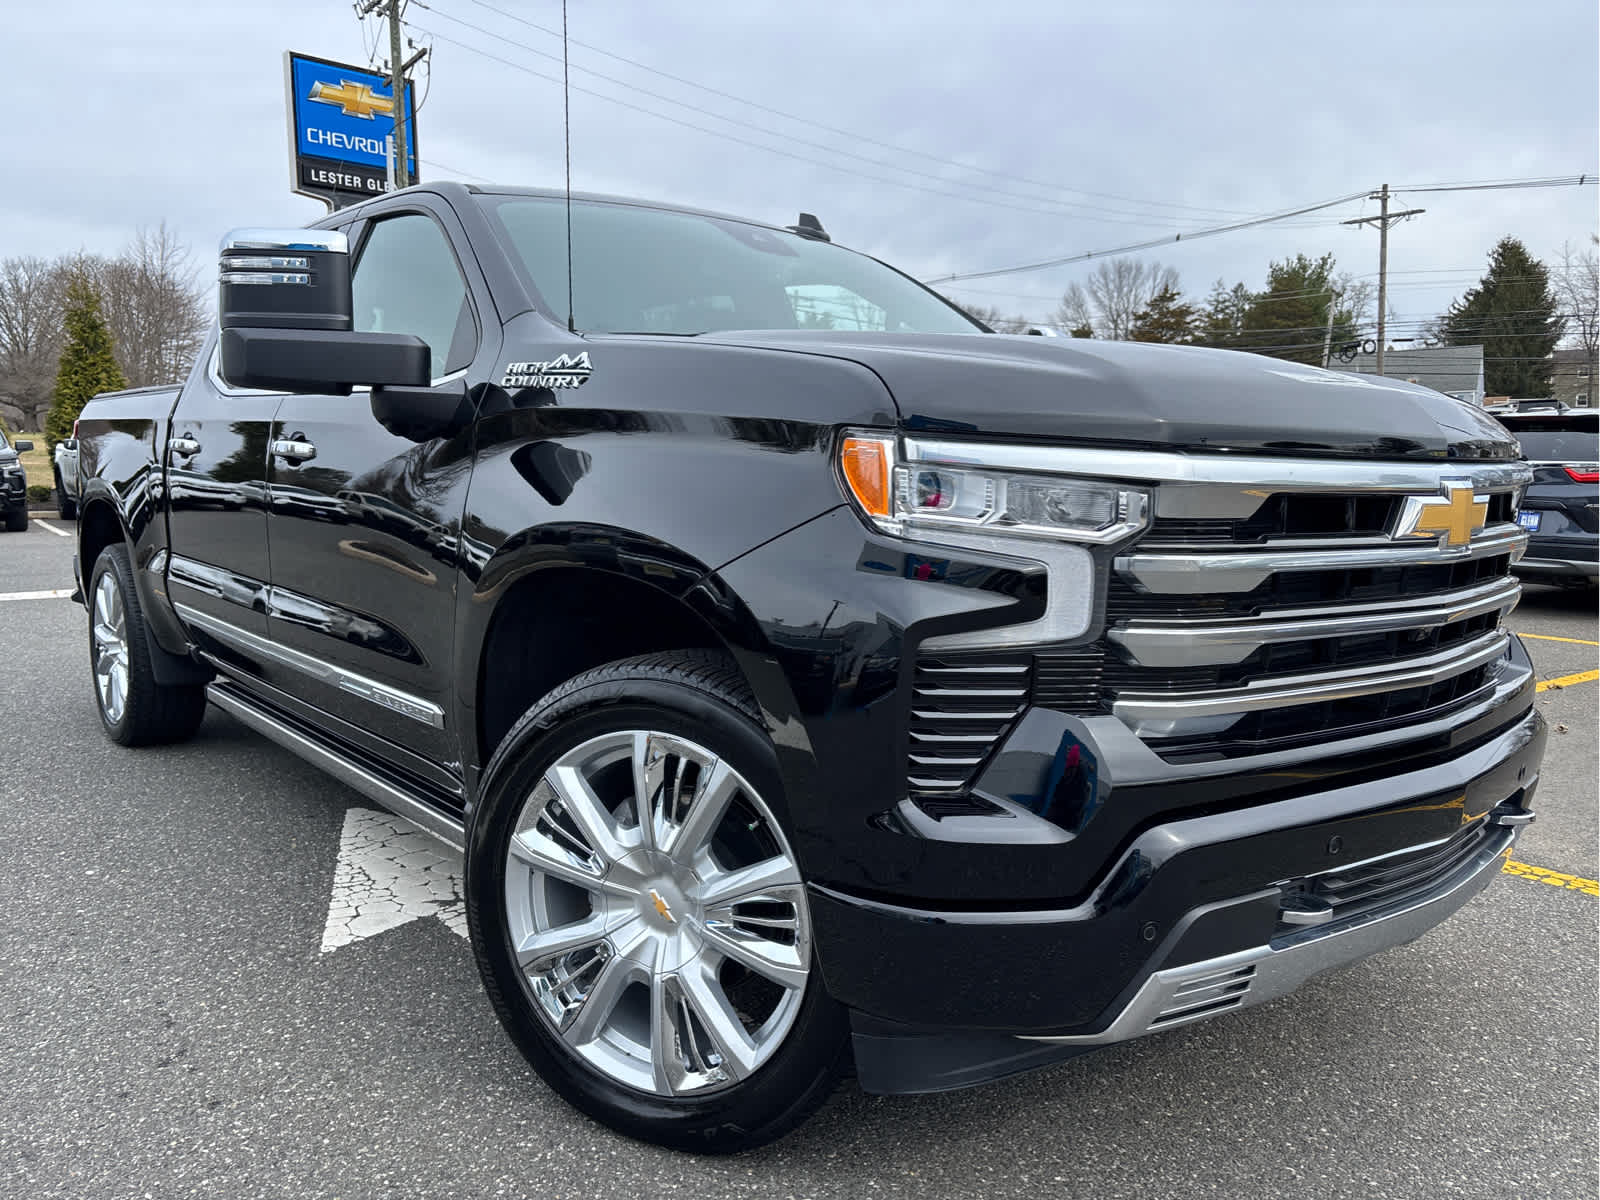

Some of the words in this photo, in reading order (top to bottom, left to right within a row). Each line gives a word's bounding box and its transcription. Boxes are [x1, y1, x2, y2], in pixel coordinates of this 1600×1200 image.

[306, 127, 400, 158] CHEVROL
[311, 168, 362, 189] LESTER
[366, 178, 399, 193] GLE
[506, 361, 550, 375] HIGH
[501, 375, 589, 389] COUNTRY
